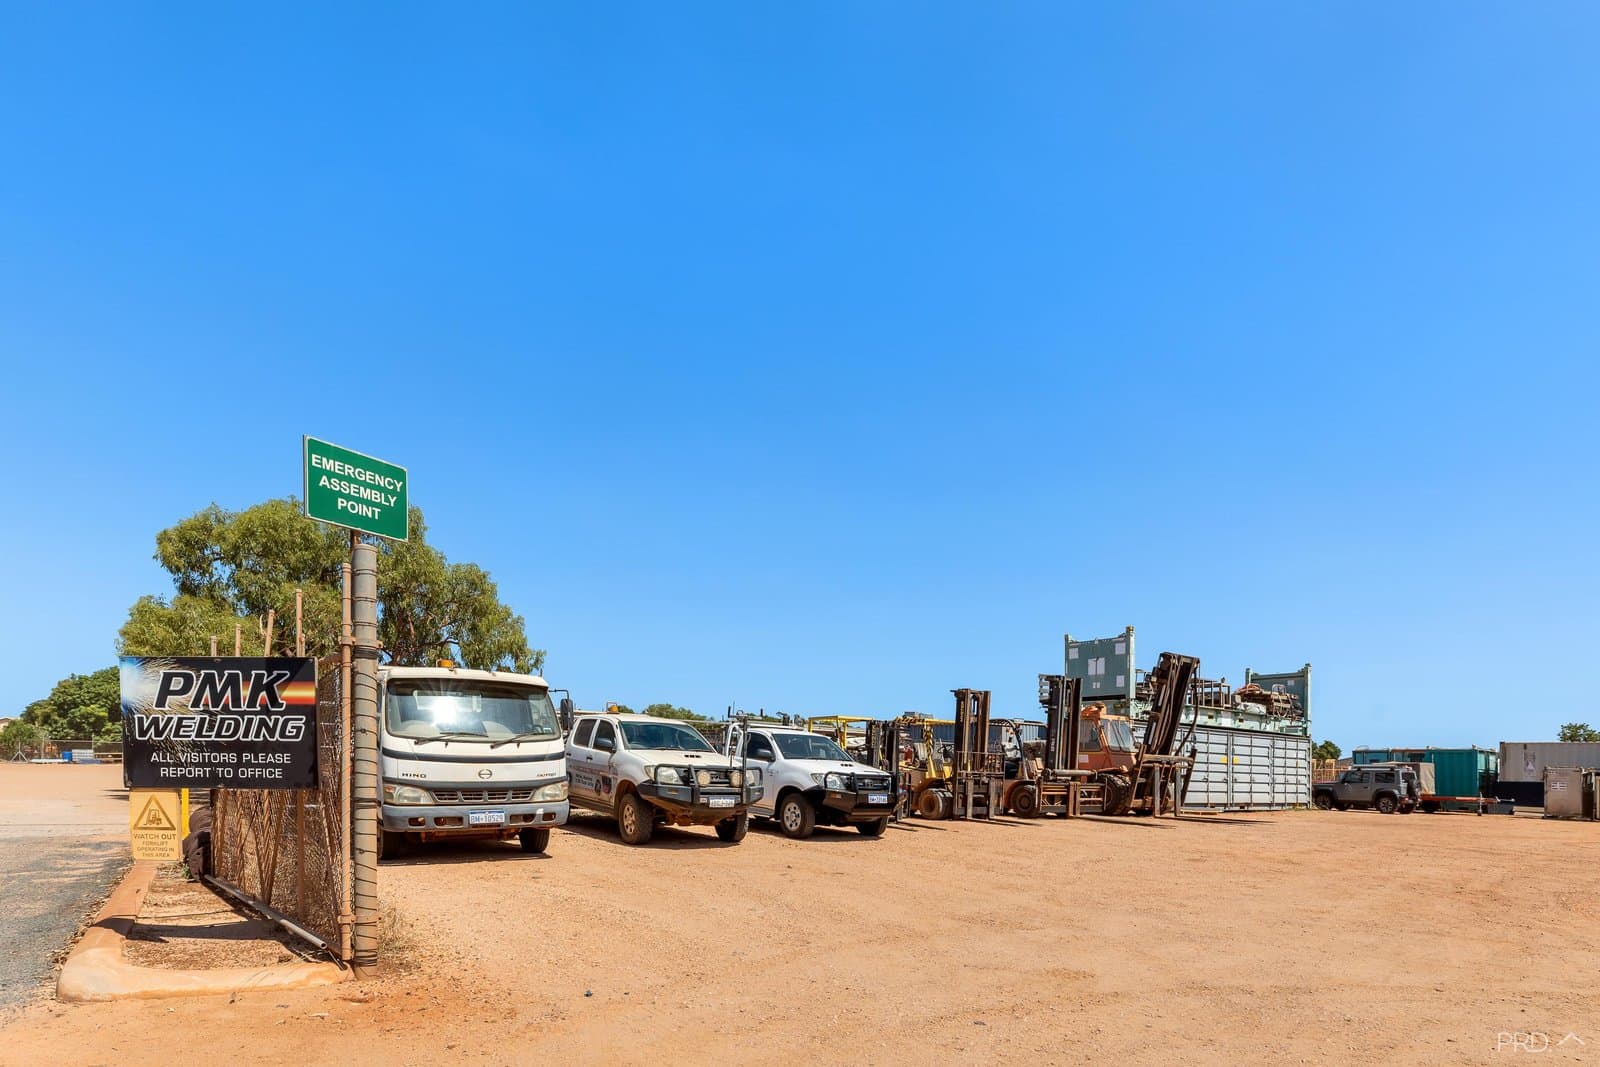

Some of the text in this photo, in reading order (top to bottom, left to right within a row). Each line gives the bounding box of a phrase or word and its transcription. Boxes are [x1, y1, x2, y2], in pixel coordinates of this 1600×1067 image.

[311, 453, 403, 492] EMERGENCY
[319, 475, 397, 508] ASSEMBLY
[337, 497, 381, 520] POINT
[153, 670, 290, 711] PMK
[134, 714, 306, 742] WELDING
[150, 752, 291, 764] ALL VISITORS PLEASE
[160, 767, 283, 779] REPORT TO OFFICE
